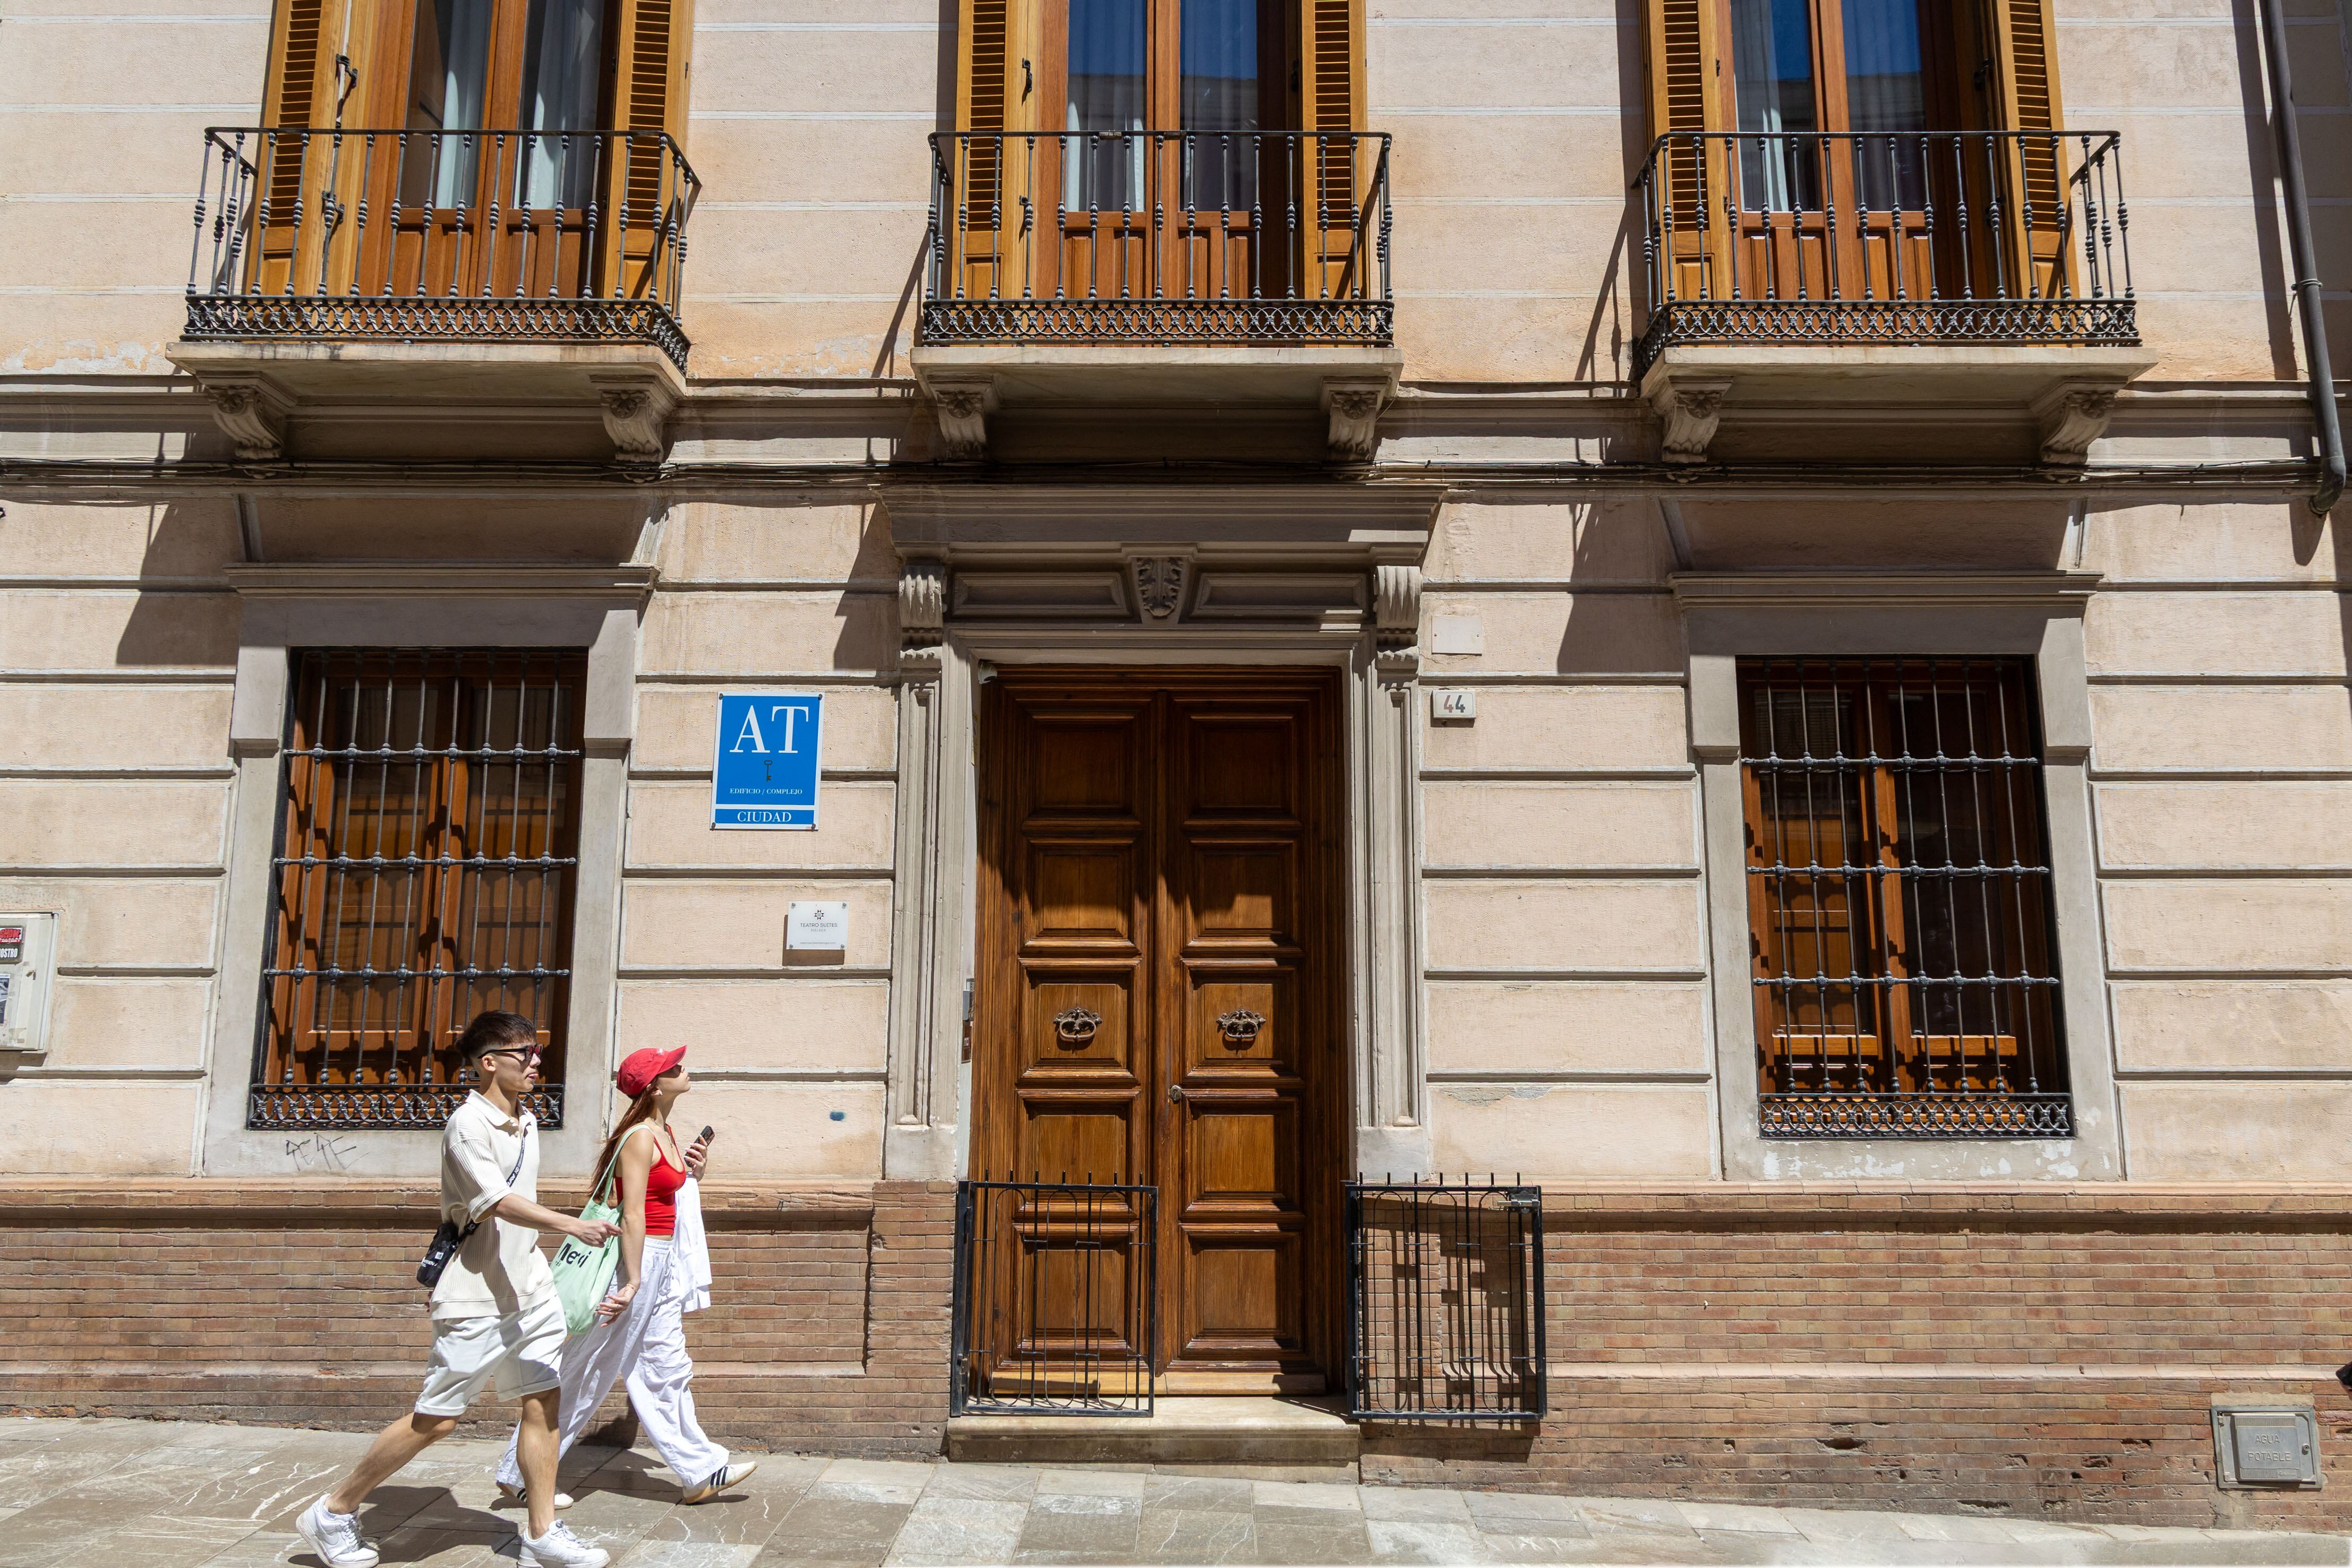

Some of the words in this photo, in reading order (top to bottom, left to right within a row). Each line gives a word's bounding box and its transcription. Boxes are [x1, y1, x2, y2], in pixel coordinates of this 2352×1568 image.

[1443, 695, 1466, 713] 44
[729, 705, 809, 753] AT
[737, 811, 792, 822] CIUDAD
[0, 948, 18, 958] OSTRO
[558, 1243, 592, 1268] Meci
[2255, 1434, 2280, 1444] AGUA
[2247, 1451, 2291, 1461] POTABLE
